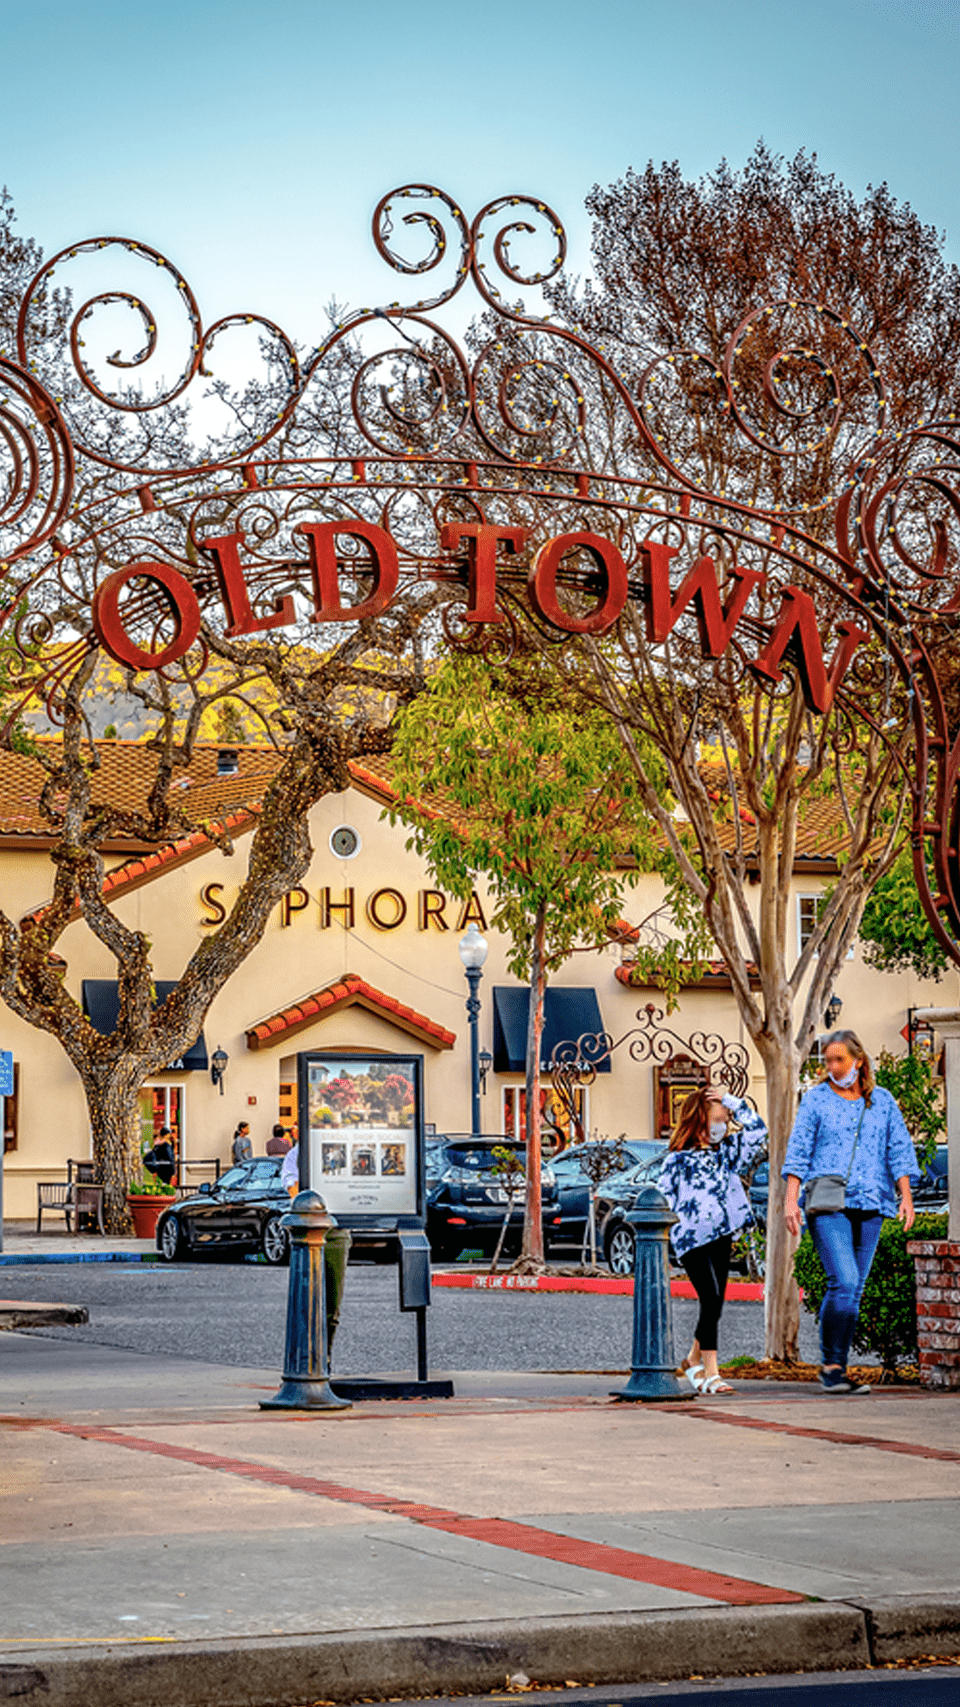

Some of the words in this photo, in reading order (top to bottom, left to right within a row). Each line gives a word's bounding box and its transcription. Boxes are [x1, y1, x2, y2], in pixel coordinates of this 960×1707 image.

[92, 518, 400, 671] OLD
[440, 522, 872, 714] TOWN
[200, 882, 488, 931] SPHORA
